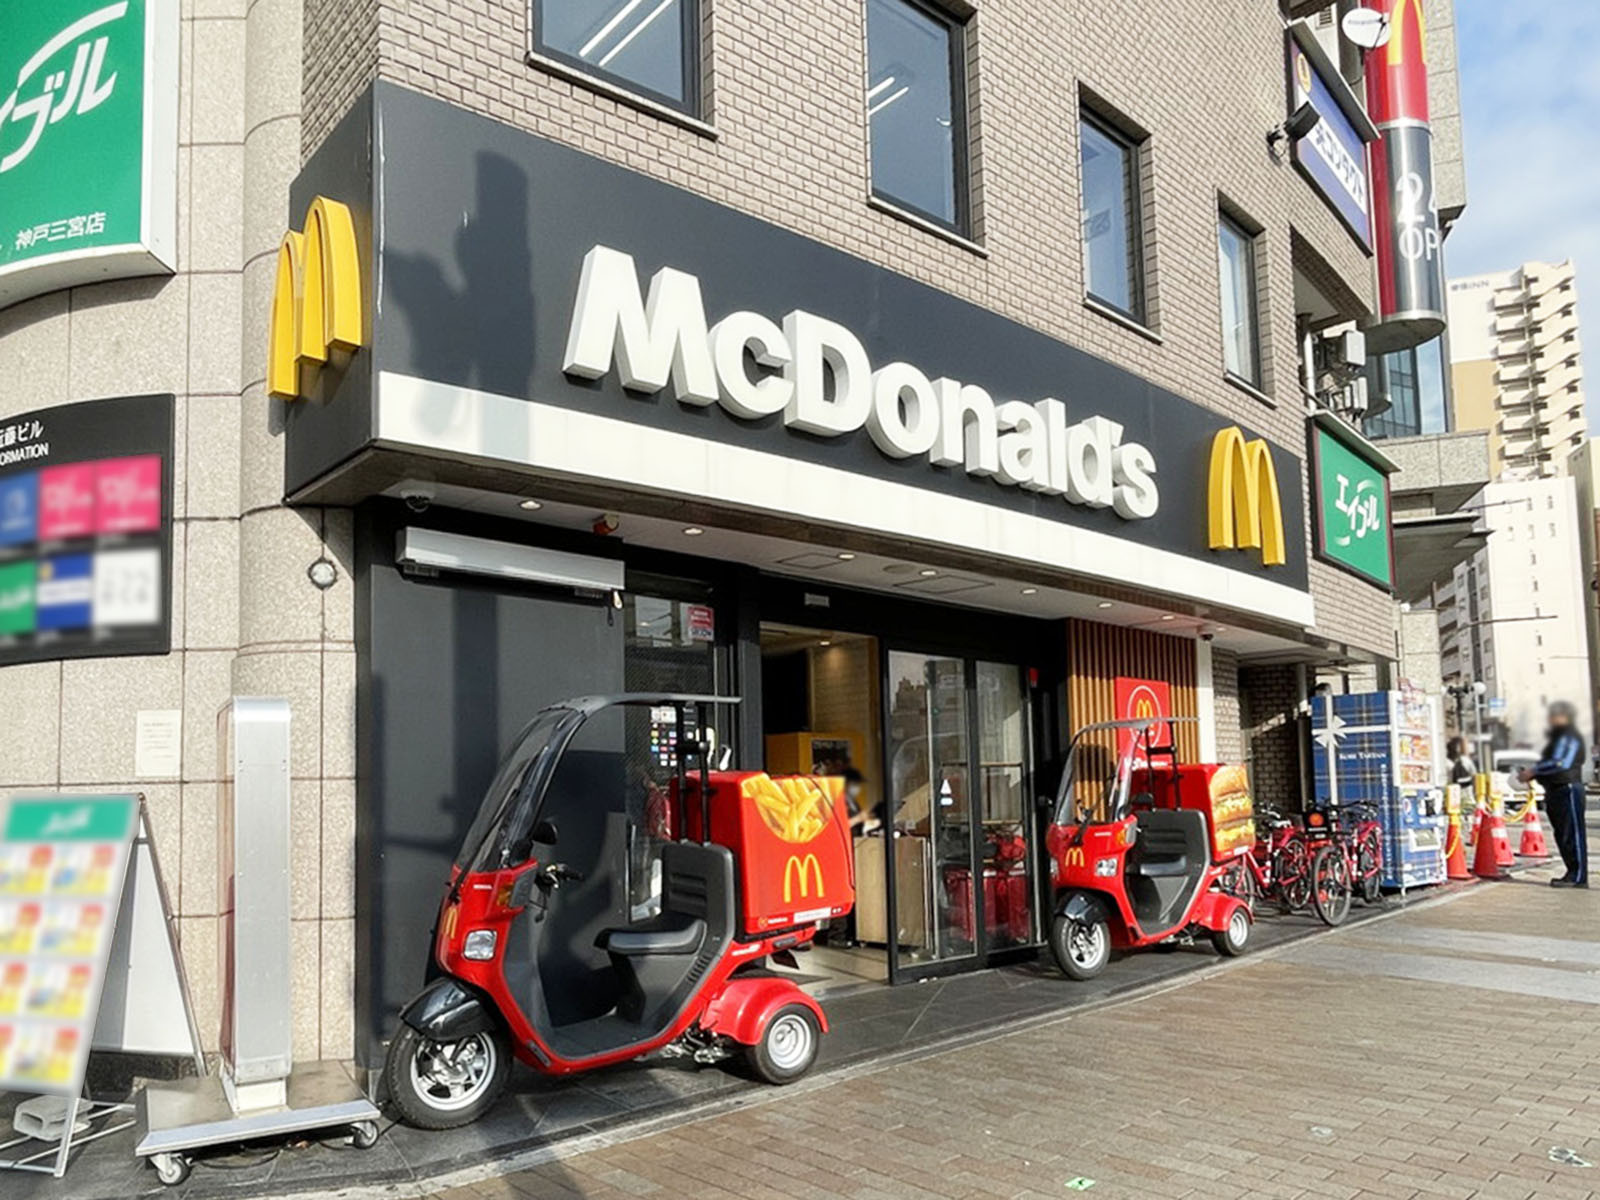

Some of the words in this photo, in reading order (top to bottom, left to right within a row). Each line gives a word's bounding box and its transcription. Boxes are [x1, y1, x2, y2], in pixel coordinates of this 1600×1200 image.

[15, 212, 106, 251] 神戸三宮店
[563, 244, 1158, 520] McDonald's
[1335, 473, 1380, 539] エイブル
